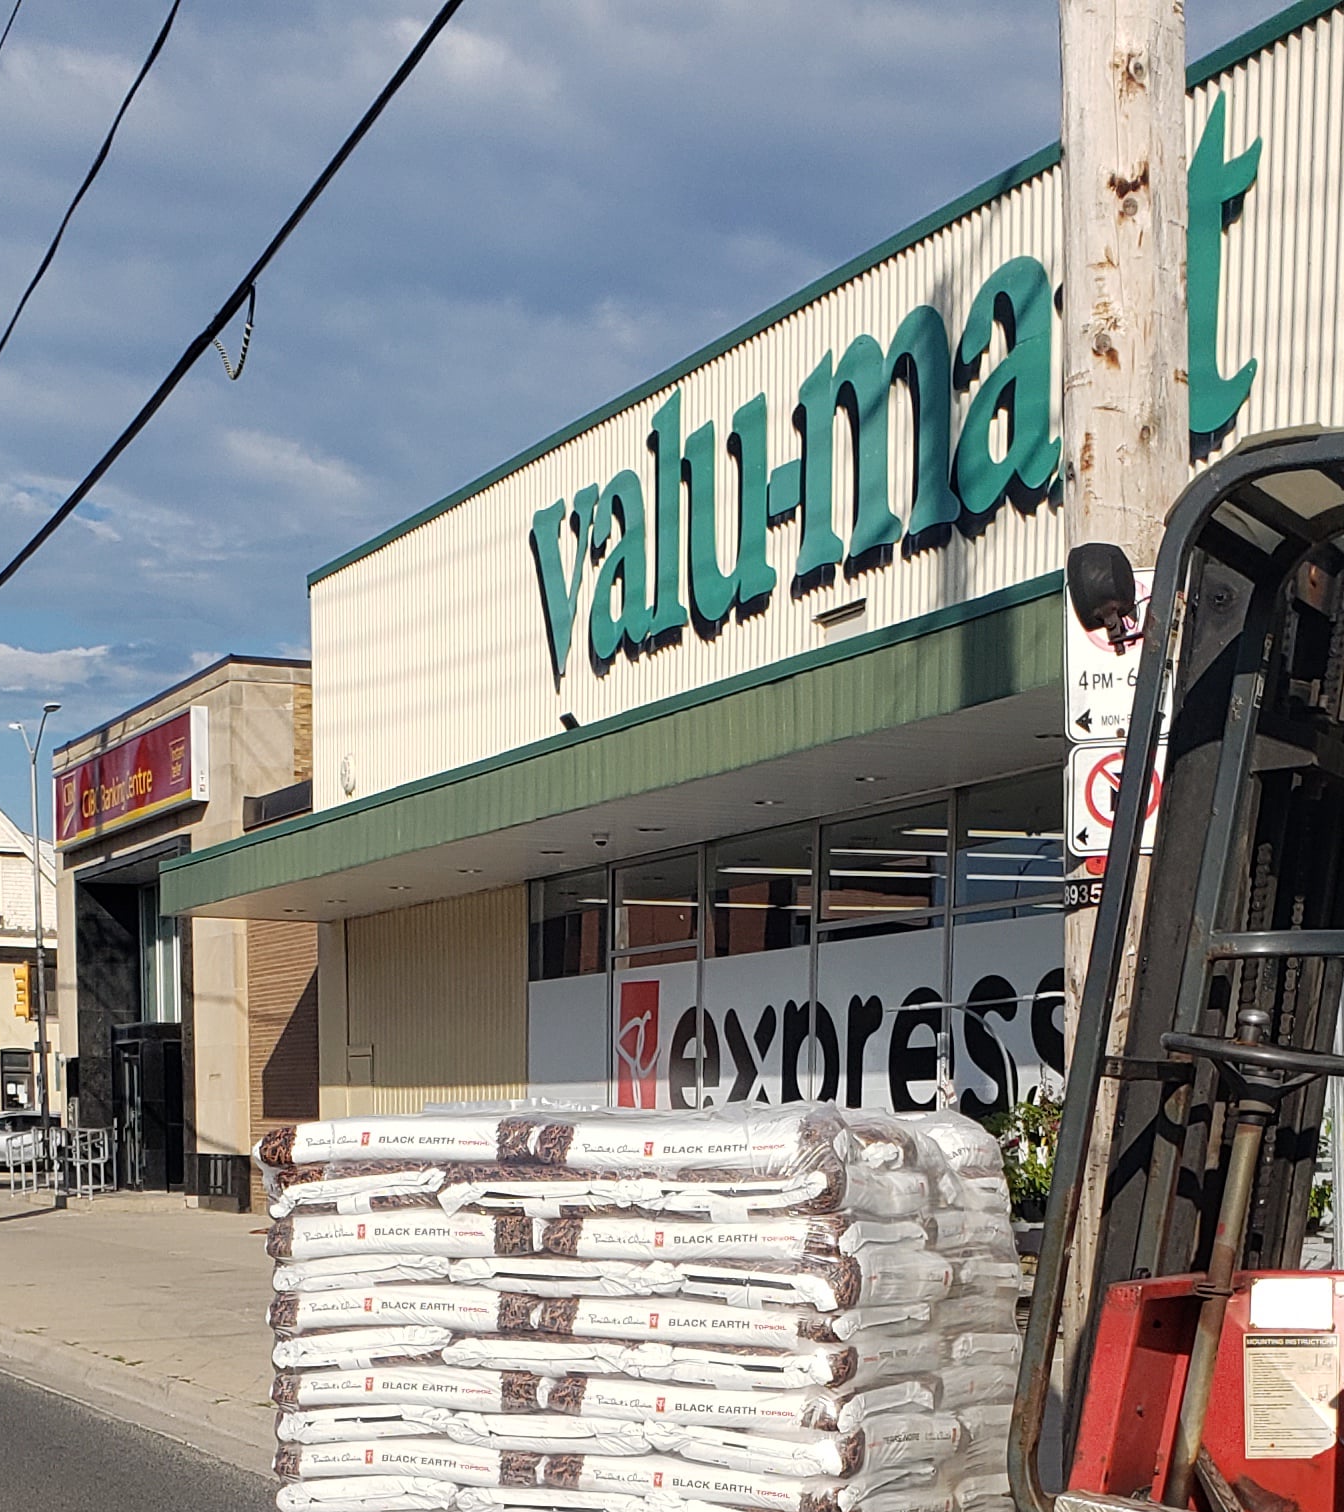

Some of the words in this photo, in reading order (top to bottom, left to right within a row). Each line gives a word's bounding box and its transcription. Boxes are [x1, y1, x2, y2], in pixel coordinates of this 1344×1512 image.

[531, 91, 1262, 676] valu-mat
[1101, 714, 1132, 726] MON-F
[1065, 883, 1103, 905] 8935
[378, 1136, 414, 1144] BLACK
[419, 1136, 455, 1145] EARTH
[663, 1145, 703, 1154] BLACK
[708, 1144, 748, 1153] EARTH
[374, 1228, 410, 1236] BLACK
[414, 1228, 450, 1236] EARTH
[673, 1235, 713, 1244] BLACK
[718, 1234, 757, 1243] EARTH
[381, 1301, 417, 1310] BLACK
[420, 1302, 455, 1311] EARTH
[669, 1319, 706, 1328] BLACK
[711, 1319, 750, 1329] EARTH
[382, 1382, 418, 1391] BLACK
[422, 1383, 458, 1393] EARTH
[675, 1403, 713, 1413] BLACK
[718, 1405, 757, 1415] EARTH
[381, 1454, 417, 1464] BLACK
[421, 1457, 456, 1468] EARTH
[672, 1478, 710, 1490] BLACK
[714, 1482, 753, 1494] EARTH
